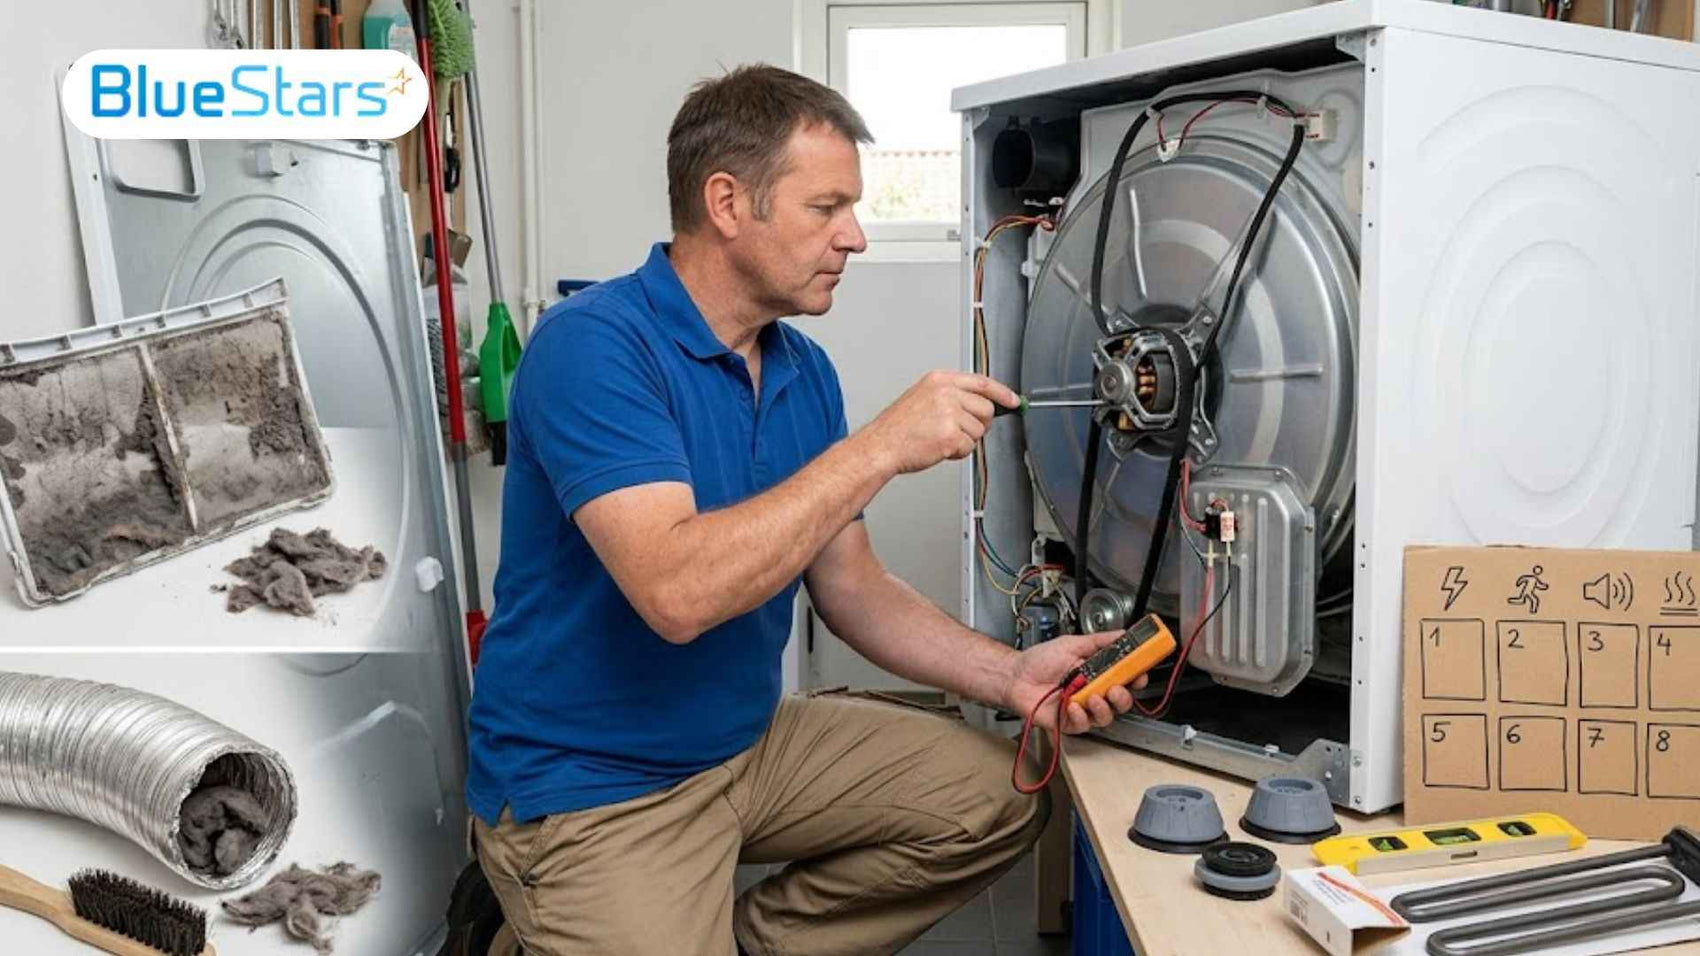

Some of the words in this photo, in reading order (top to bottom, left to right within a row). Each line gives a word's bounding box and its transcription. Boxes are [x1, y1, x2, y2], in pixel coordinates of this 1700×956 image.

[1429, 626, 1440, 647] 1
[1507, 628, 1525, 649] 2
[1587, 631, 1605, 652] 3
[1656, 633, 1672, 656] 4
[1430, 721, 1451, 742] 5
[1505, 723, 1522, 745] 6
[1587, 727, 1605, 748] 7
[1655, 730, 1671, 752] 8
